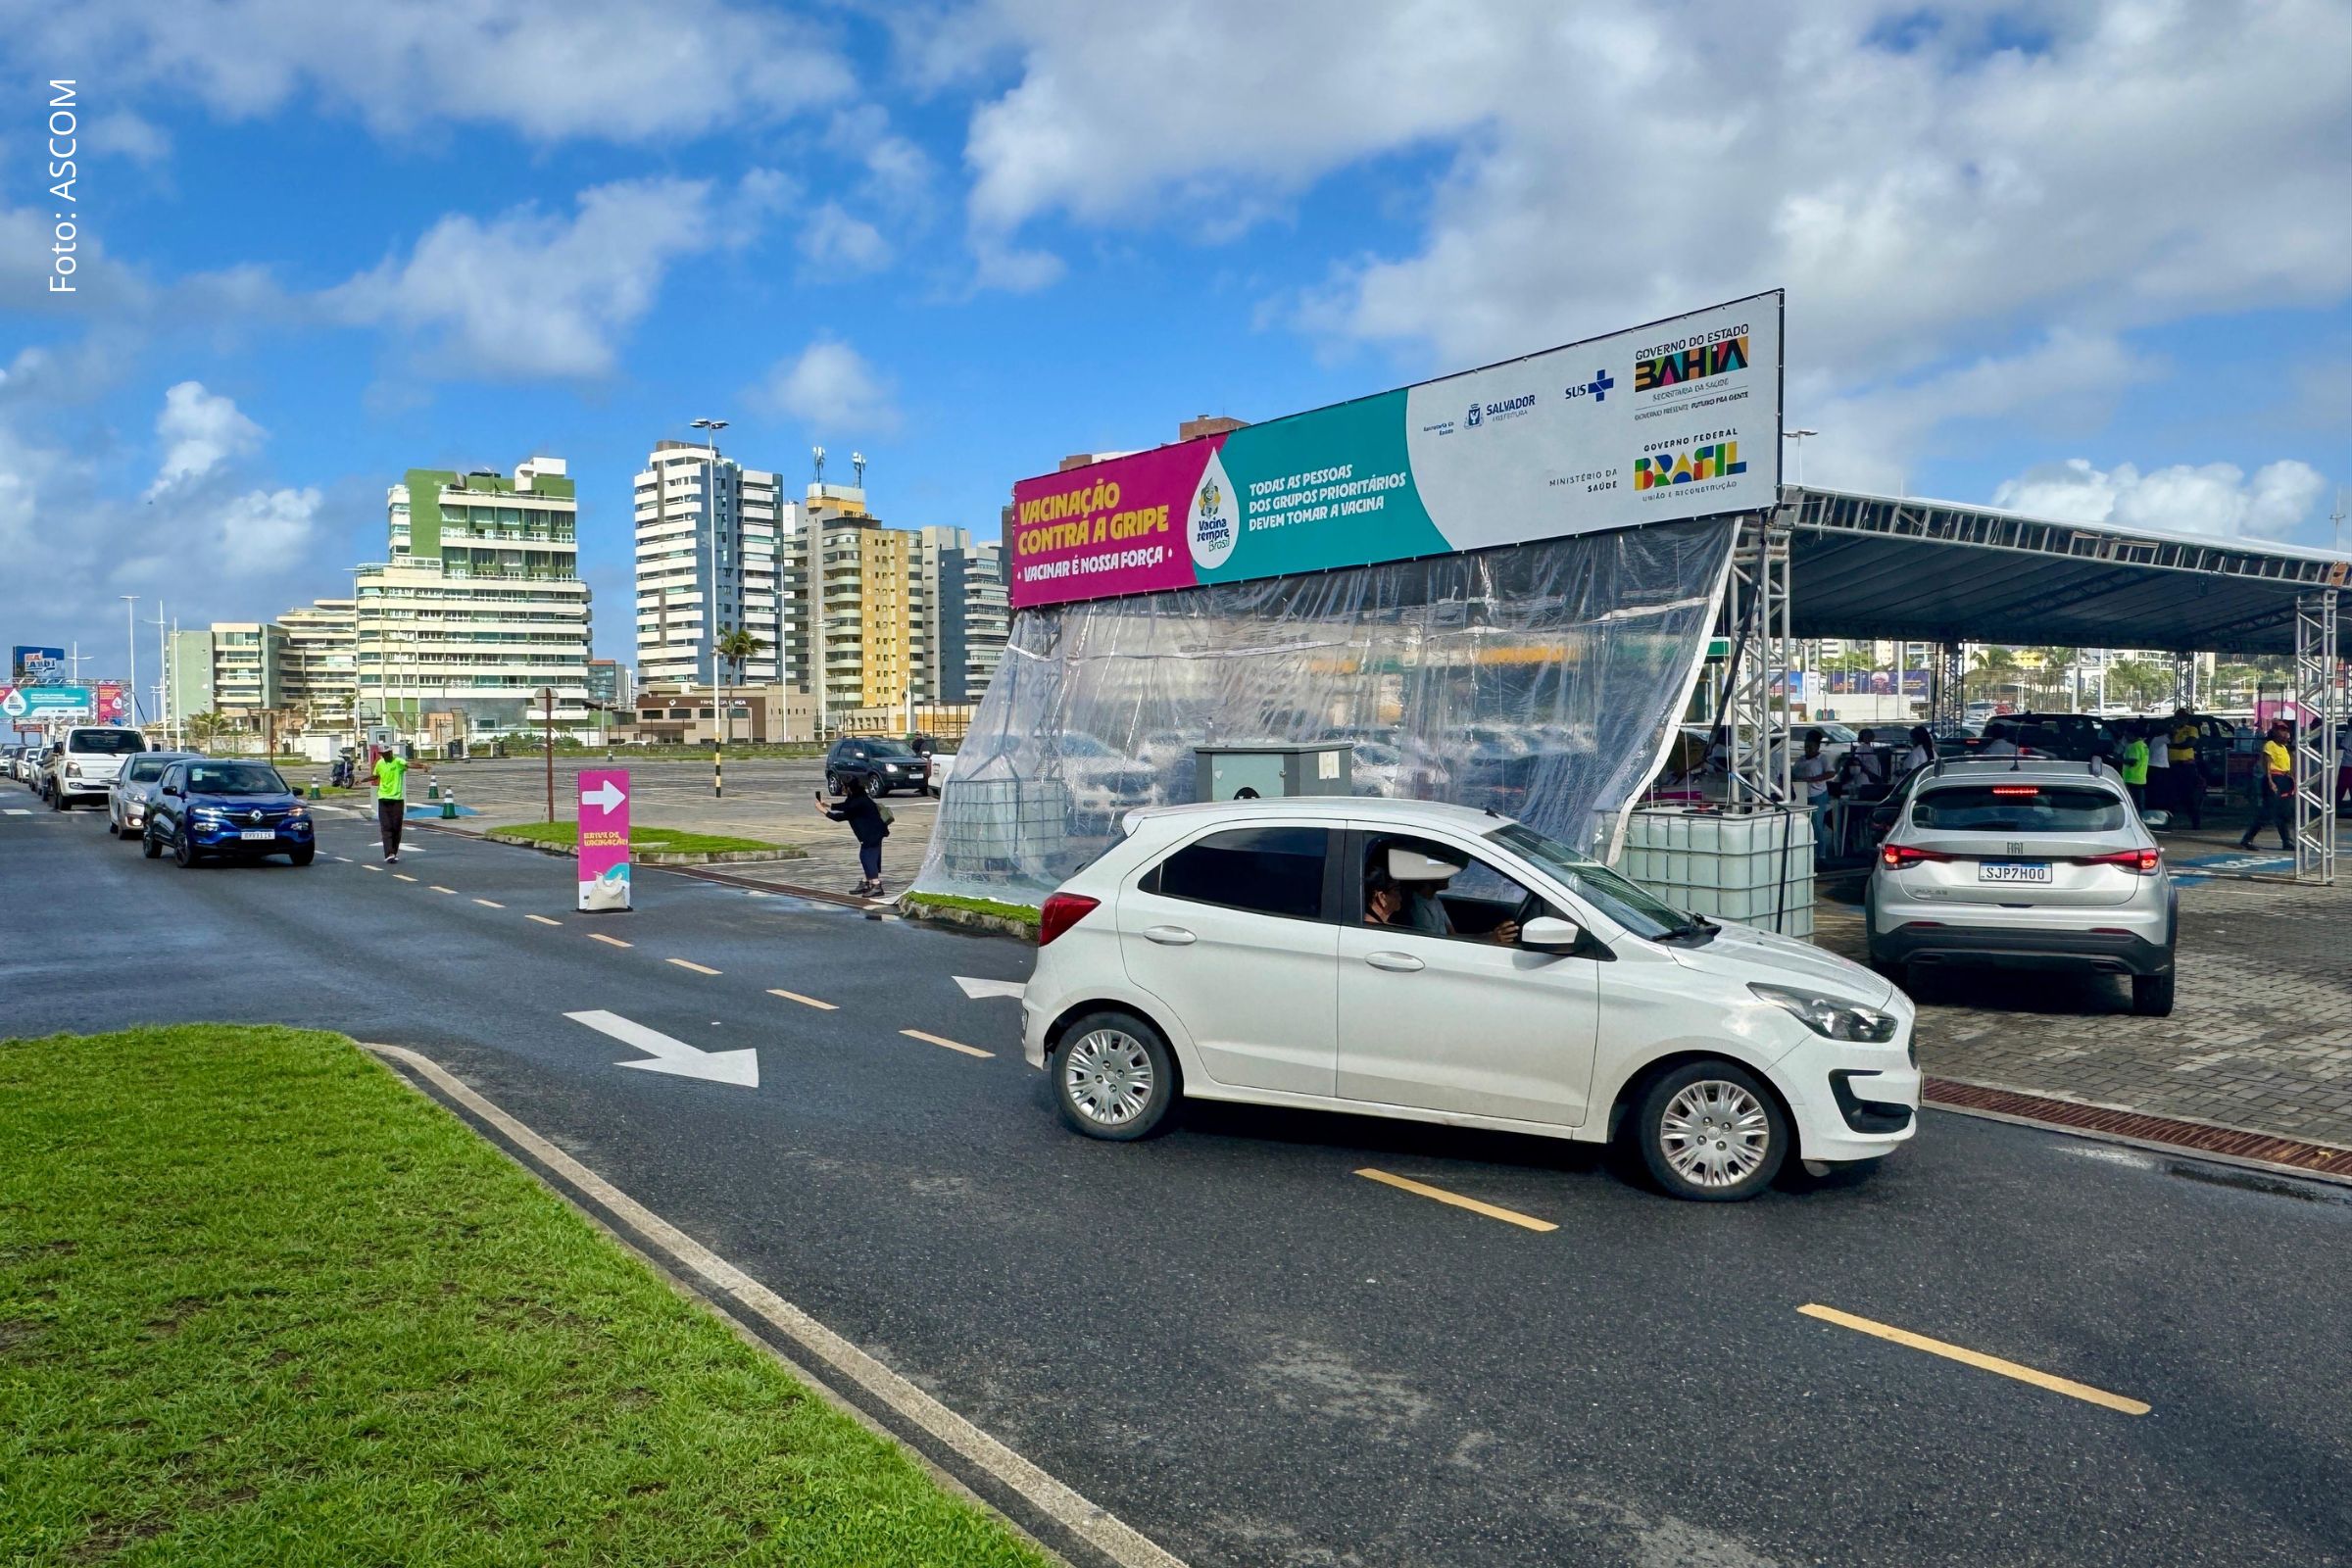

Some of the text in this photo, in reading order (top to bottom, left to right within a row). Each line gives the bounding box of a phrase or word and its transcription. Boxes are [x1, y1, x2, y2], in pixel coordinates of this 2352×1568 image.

[1635, 323, 1749, 361] GOVERNO DO ESTADO
[1635, 337, 1748, 392] BAHIA
[1486, 394, 1536, 416] SALVADOR
[1565, 384, 1587, 400] SUS
[1643, 427, 1739, 453] GOVERNO FEDERAL
[1249, 464, 1352, 497] TODAS AS PESSOAS
[1549, 468, 1617, 487] MINISTÉRIO DA
[1635, 441, 1747, 492] BRASIL
[1019, 478, 1120, 525] VACINAÇÃO
[1249, 471, 1406, 514] DOS GRUPOS PRIORITÁRIOS
[1587, 480, 1617, 493] SAÚDE
[1199, 516, 1227, 531] Vacina
[1249, 495, 1385, 531] DEVEM TOMAR A VACINA
[1018, 505, 1169, 556] CONTRA A GRIPE
[1197, 528, 1230, 542] sempre
[1024, 545, 1162, 581] VACINAR É NOSSA FORÇA
